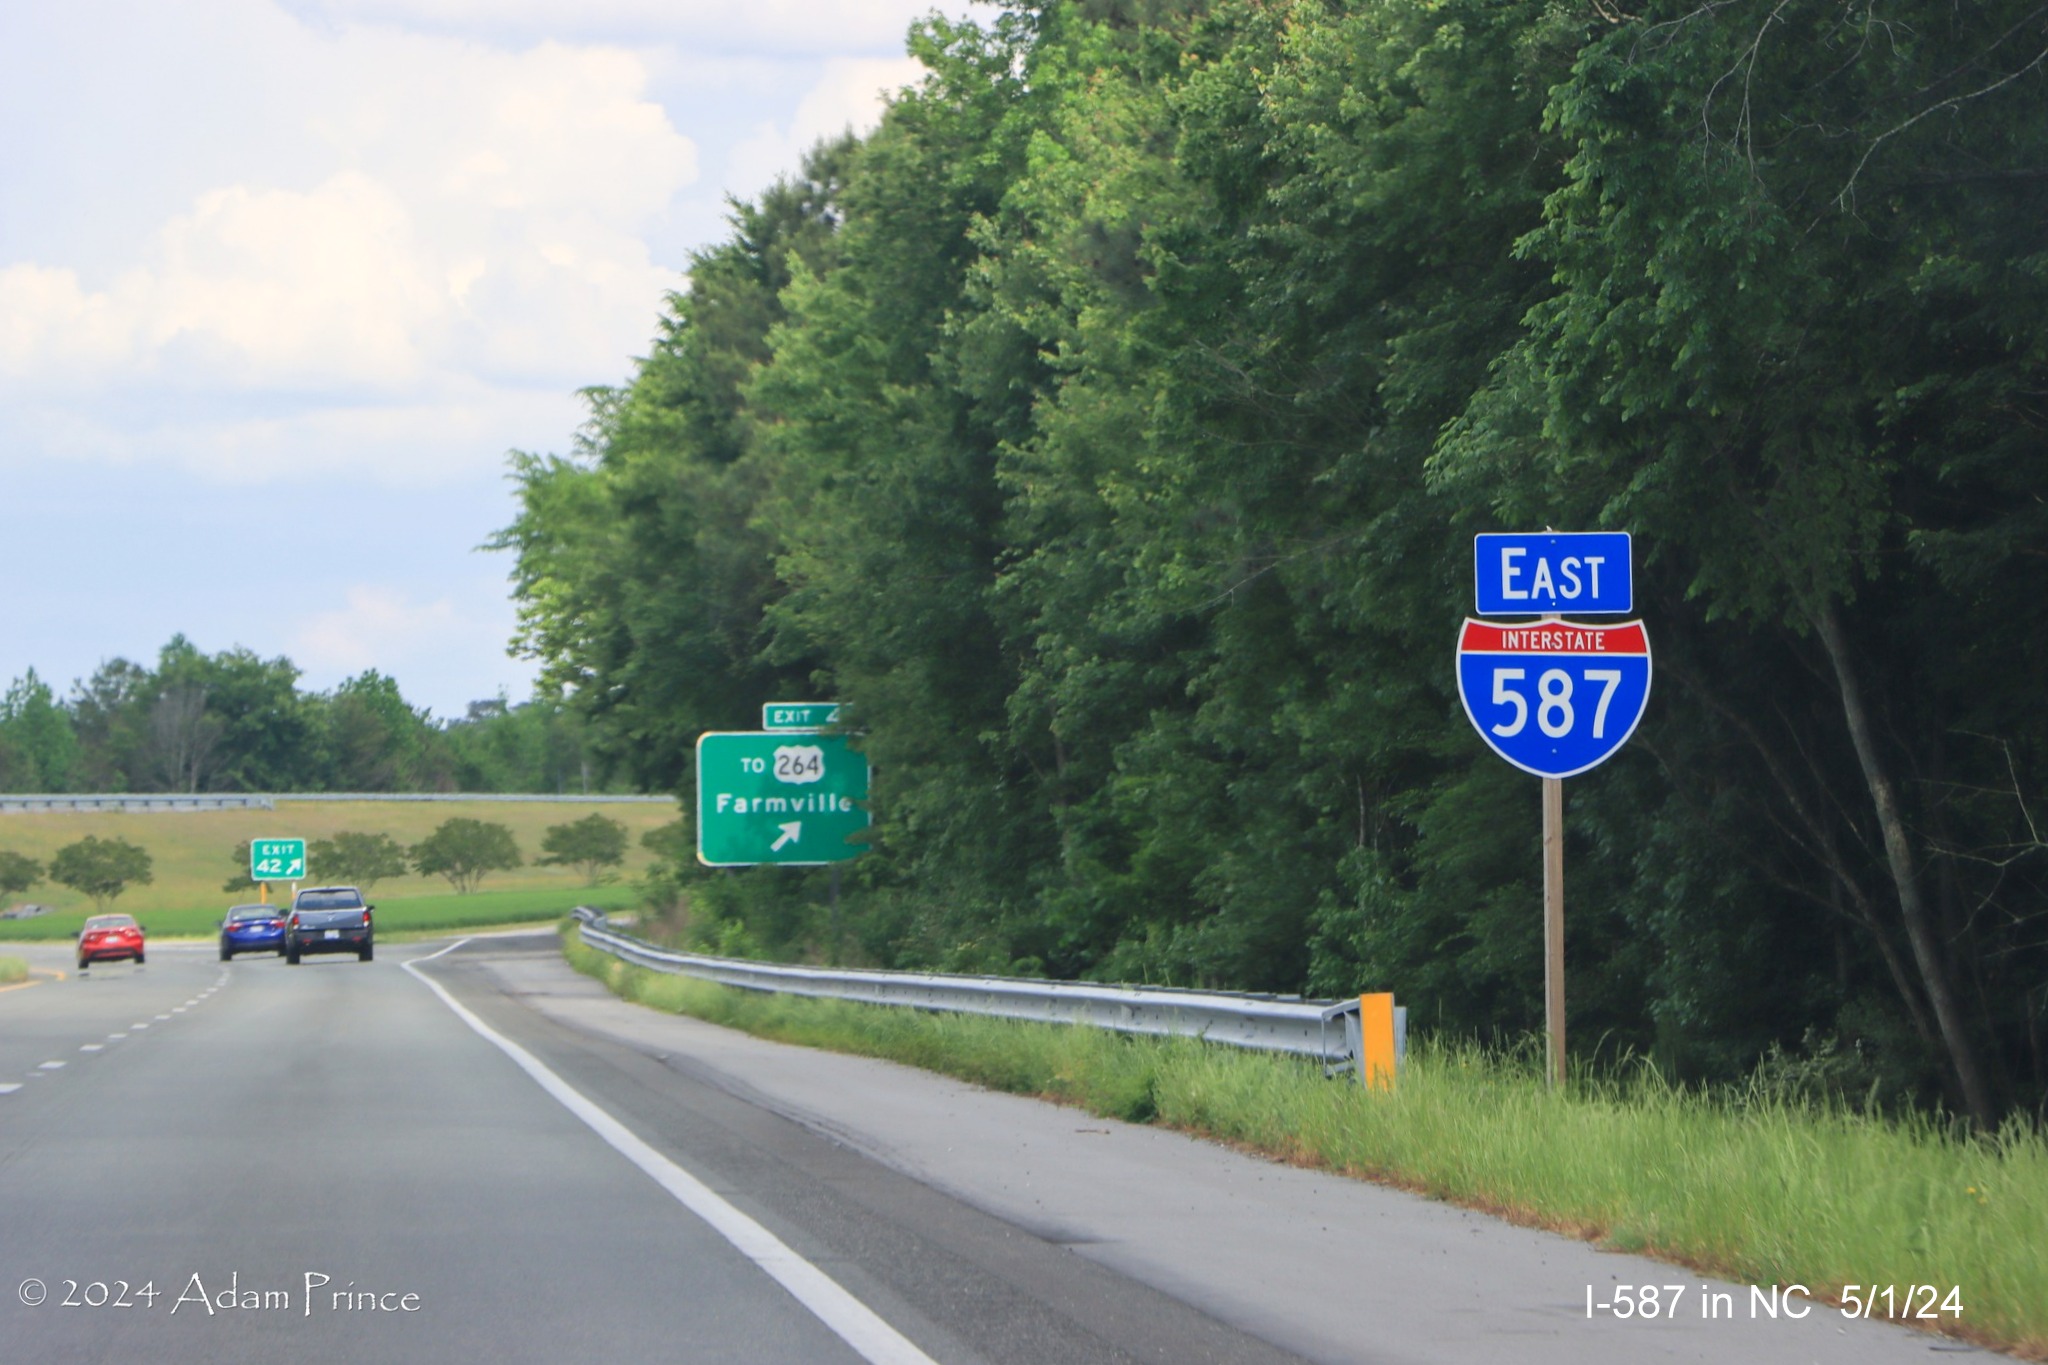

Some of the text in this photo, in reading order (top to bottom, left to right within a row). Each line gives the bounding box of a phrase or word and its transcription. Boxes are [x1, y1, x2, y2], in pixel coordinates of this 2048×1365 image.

[1501, 547, 1605, 600] EAST
[1502, 631, 1605, 650] INTERSTATE
[1491, 668, 1622, 739] 587
[773, 709, 811, 723] EXIT
[740, 754, 820, 776] TO 264
[716, 793, 852, 814] Farmville
[262, 844, 295, 855] EXIT
[256, 858, 282, 873] 42
